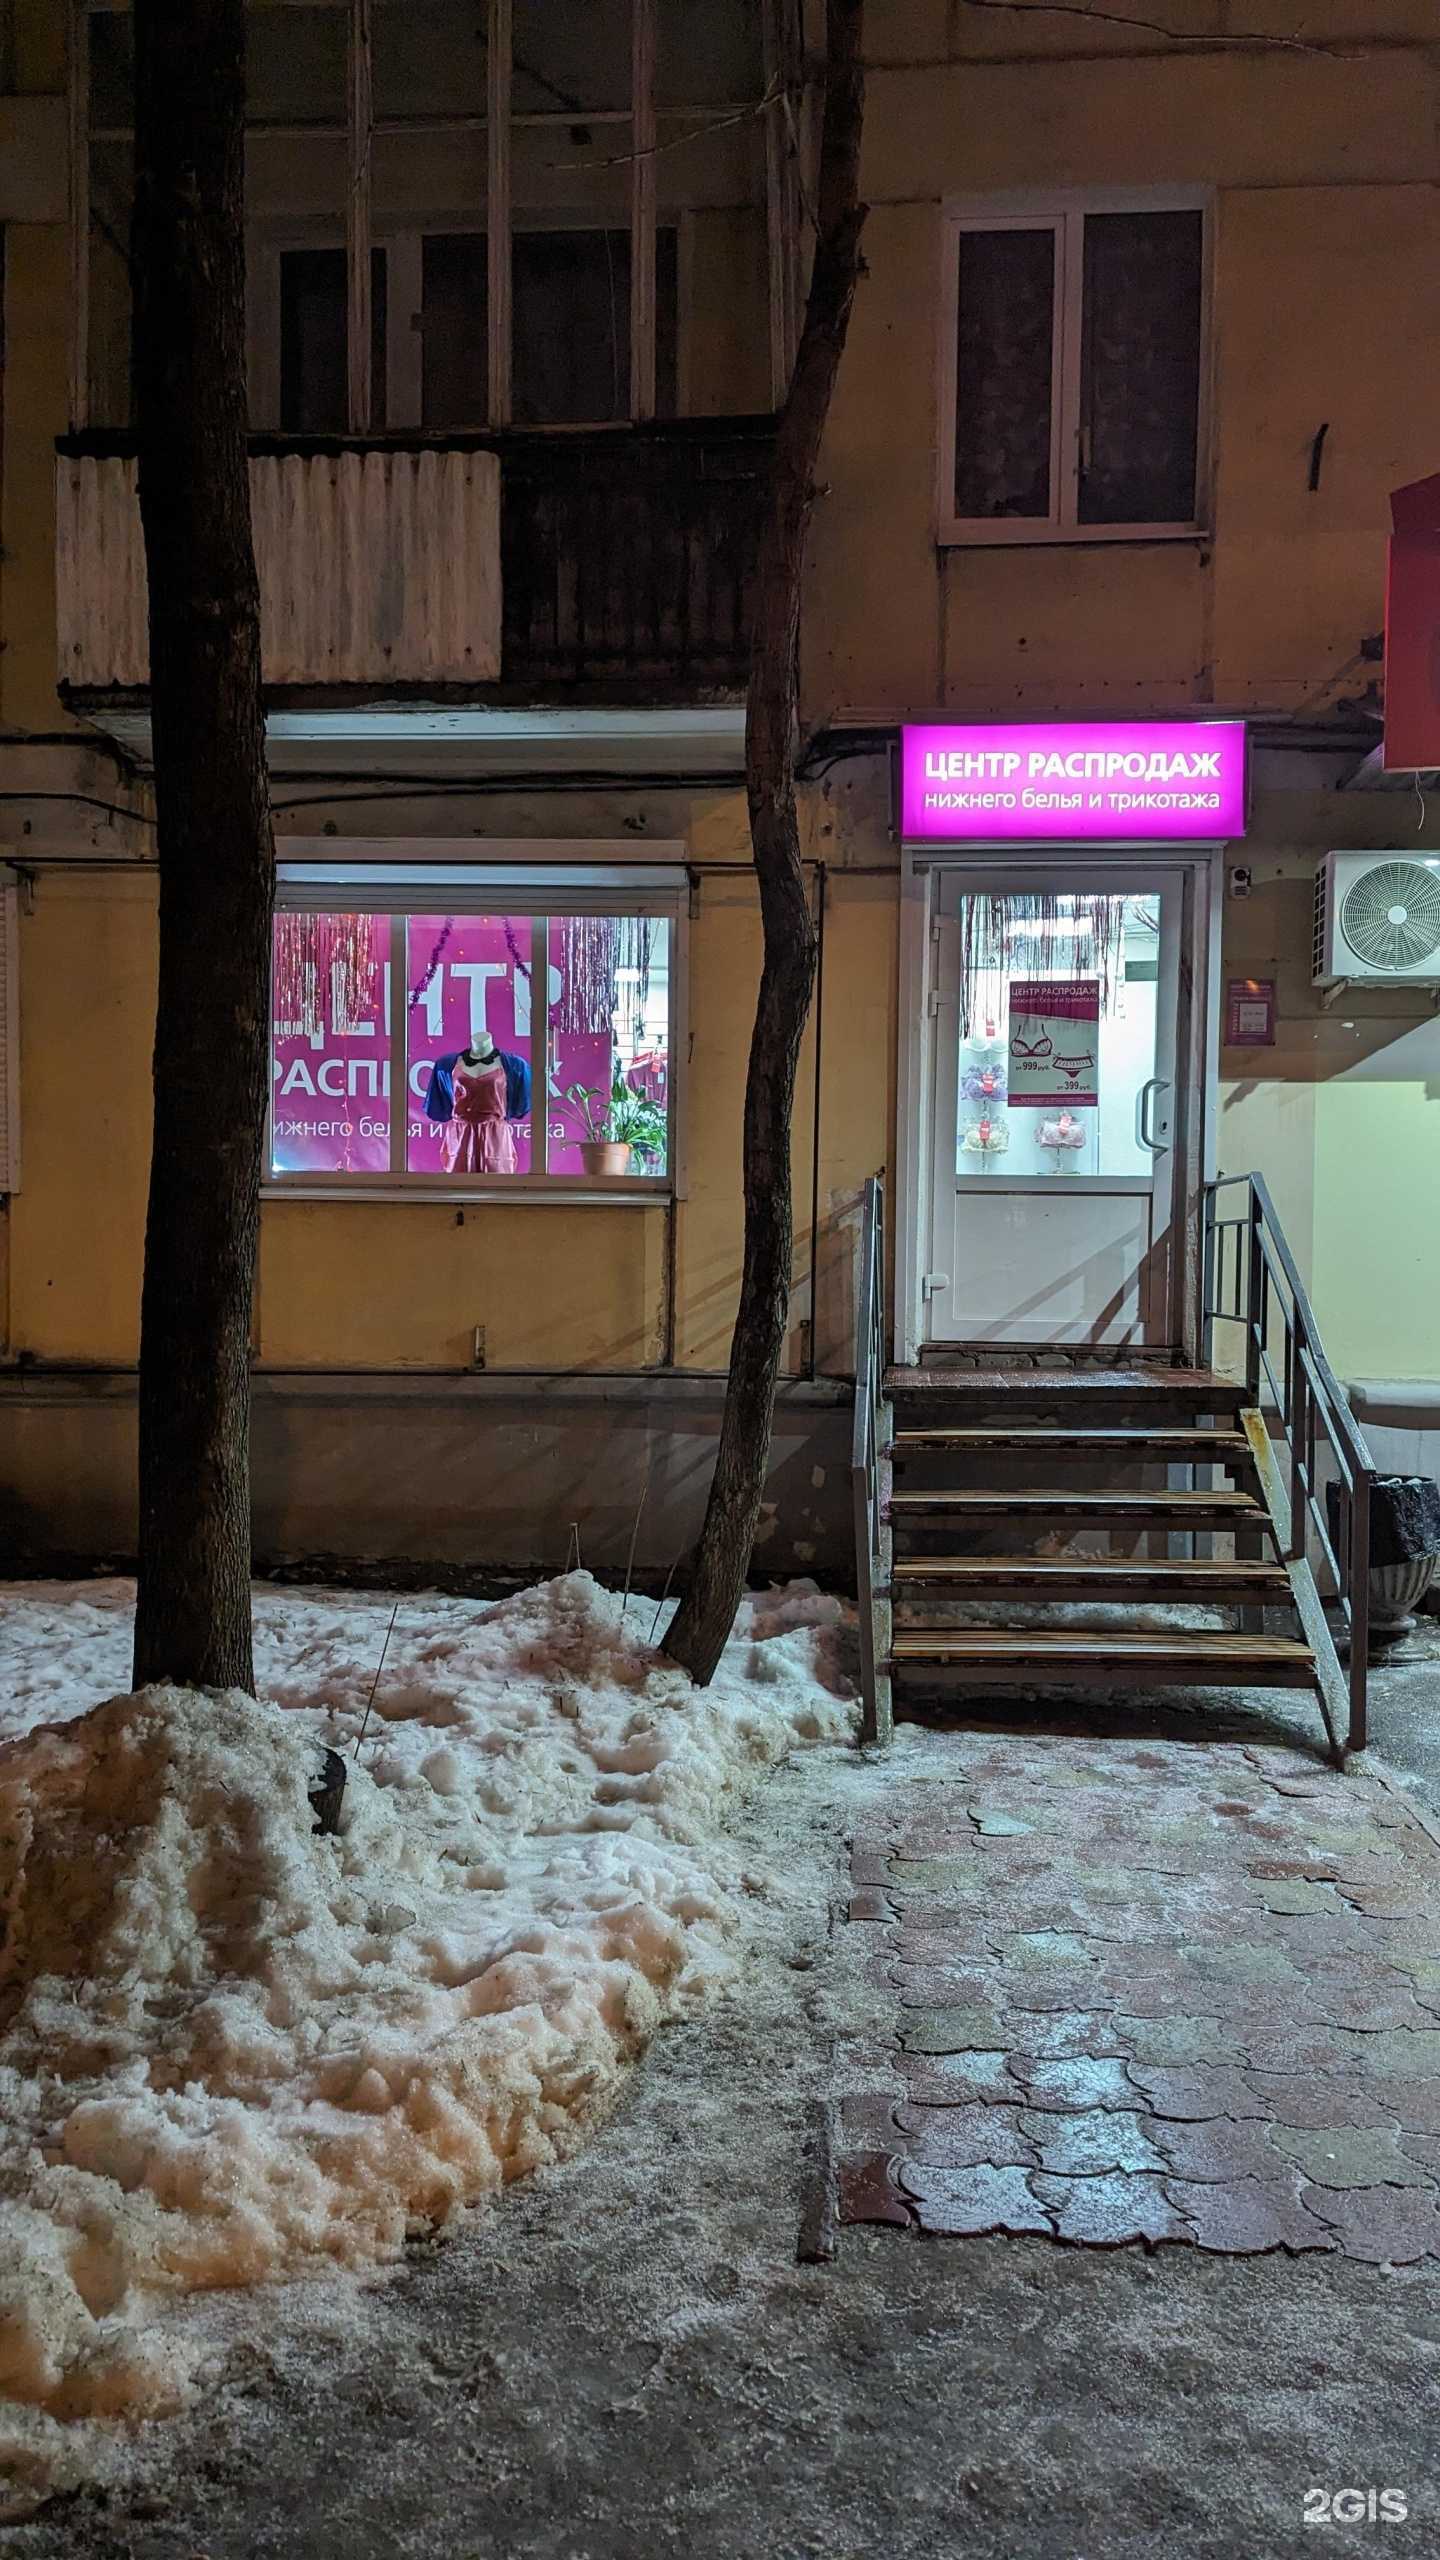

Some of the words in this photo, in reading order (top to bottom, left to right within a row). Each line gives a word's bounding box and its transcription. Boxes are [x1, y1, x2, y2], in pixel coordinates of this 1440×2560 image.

[925, 752, 1021, 781] ЦЕНТР
[1028, 751, 1221, 782] РАСПРОДАЖ
[924, 792, 1016, 809] нижнего
[1022, 787, 1083, 809] белья
[1088, 792, 1101, 809] и
[1108, 791, 1220, 813] трикотажа
[1011, 987, 1040, 997] ЦЕНТР
[1041, 986, 1098, 997] РАСПРОДАЖ
[1022, 1061, 1038, 1071] 999
[1064, 1080, 1079, 1090] 399
